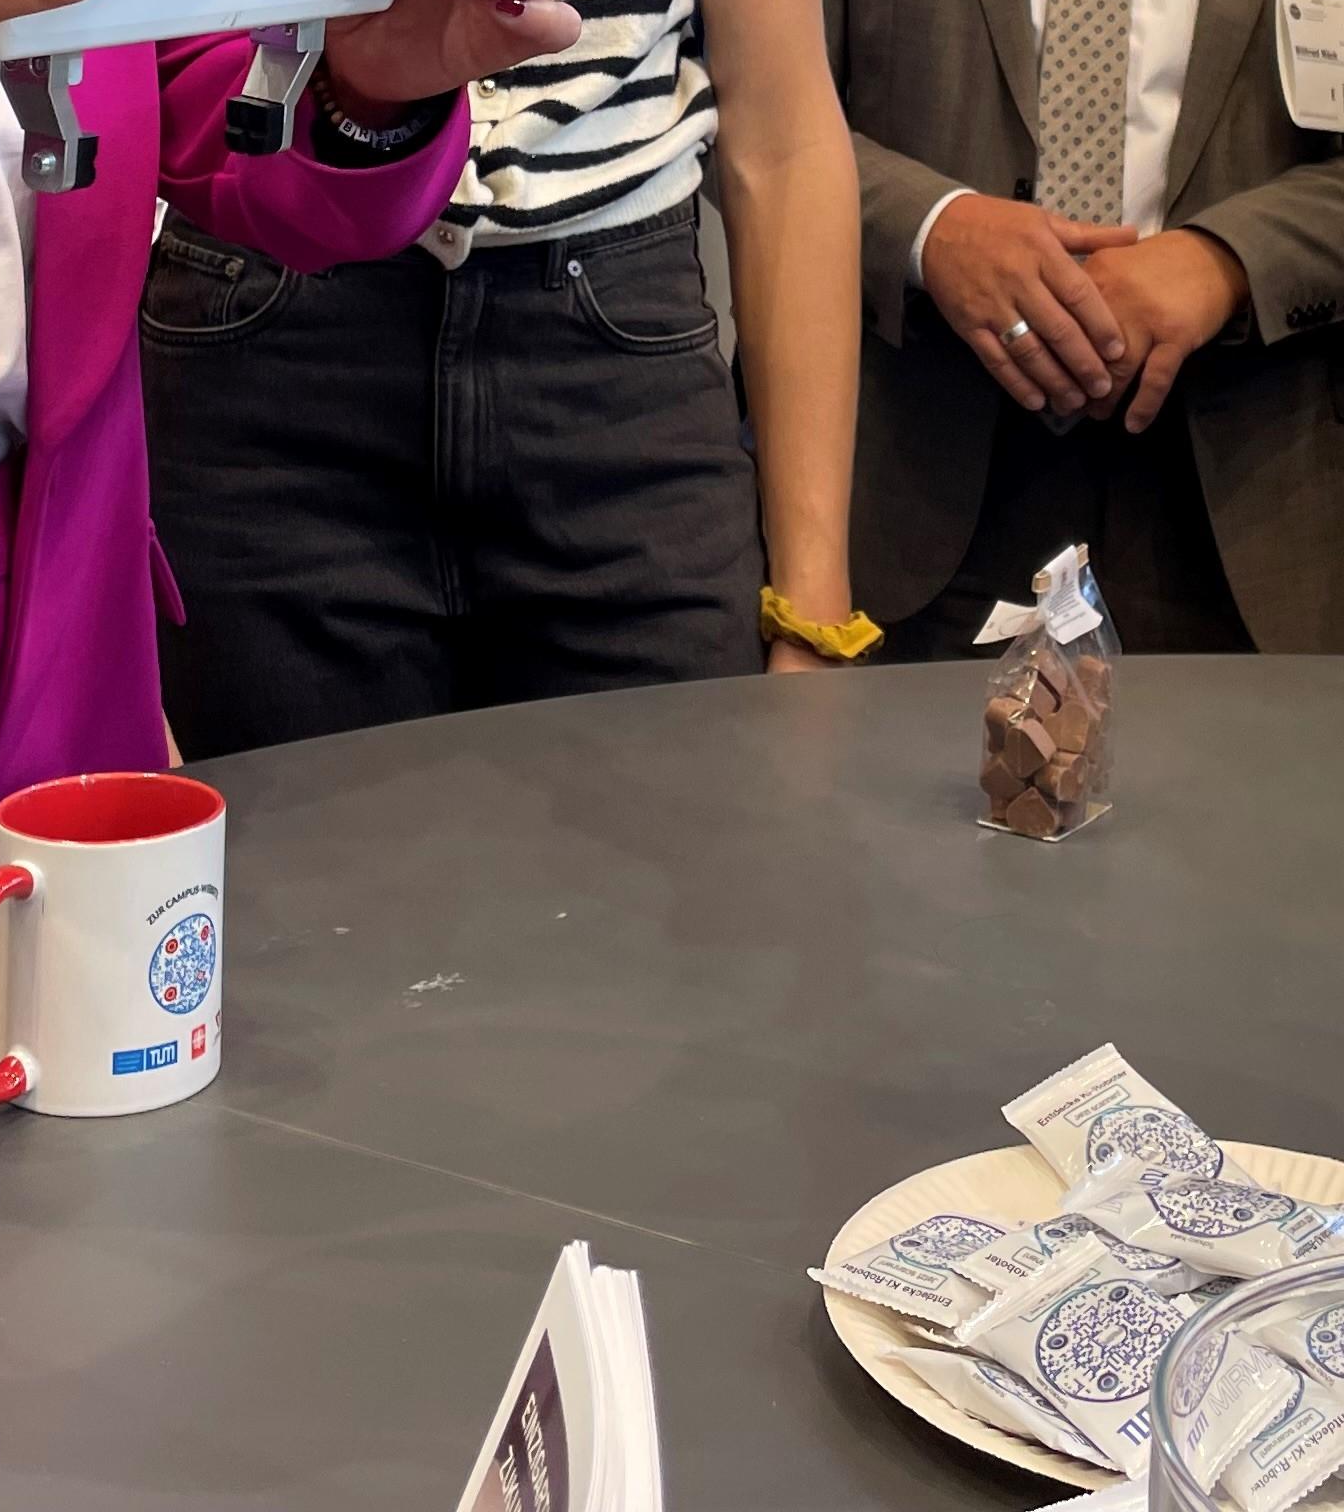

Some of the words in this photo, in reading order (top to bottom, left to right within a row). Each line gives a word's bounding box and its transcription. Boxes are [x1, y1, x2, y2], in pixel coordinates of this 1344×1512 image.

[146, 904, 166, 926] ZUR
[165, 884, 200, 909] CAMPUS
[149, 1044, 176, 1064] TUM
